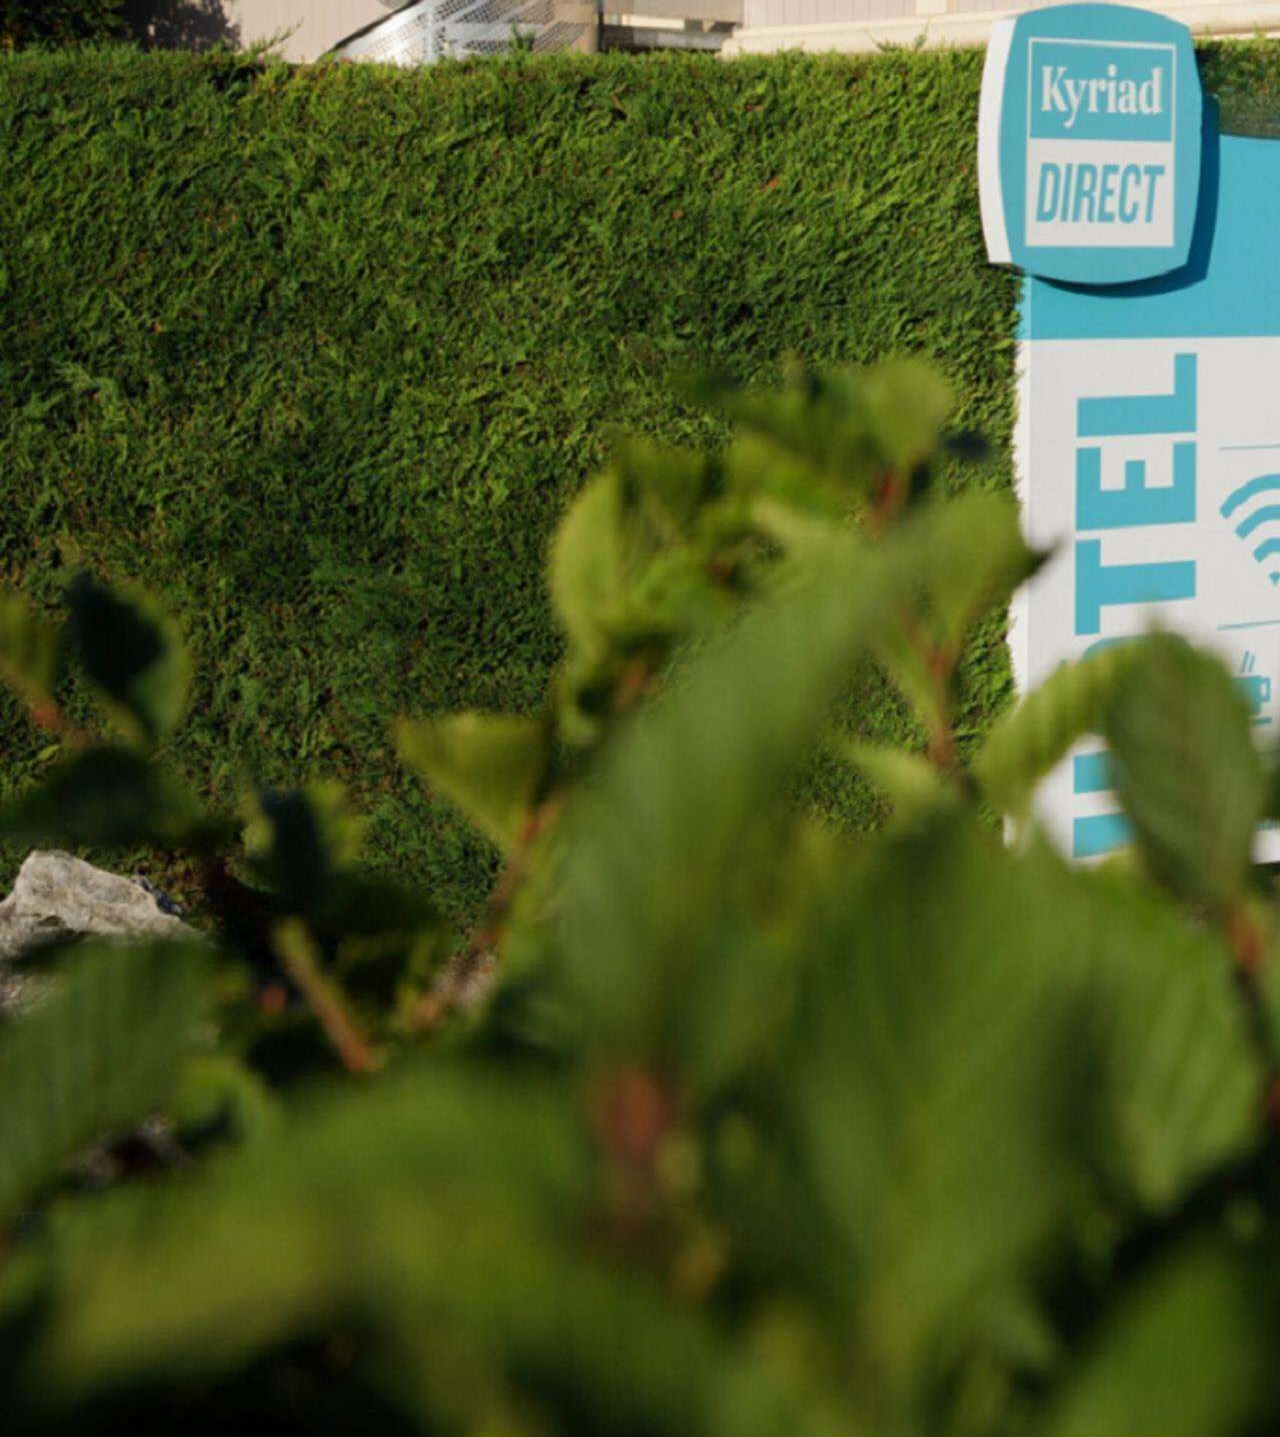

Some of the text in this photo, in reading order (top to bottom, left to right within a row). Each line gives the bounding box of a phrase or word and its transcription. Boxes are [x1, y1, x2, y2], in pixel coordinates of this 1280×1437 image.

[1040, 64, 1163, 128] Kyriad
[1035, 162, 1165, 224] DIRECT
[1074, 352, 1198, 858] TEL
